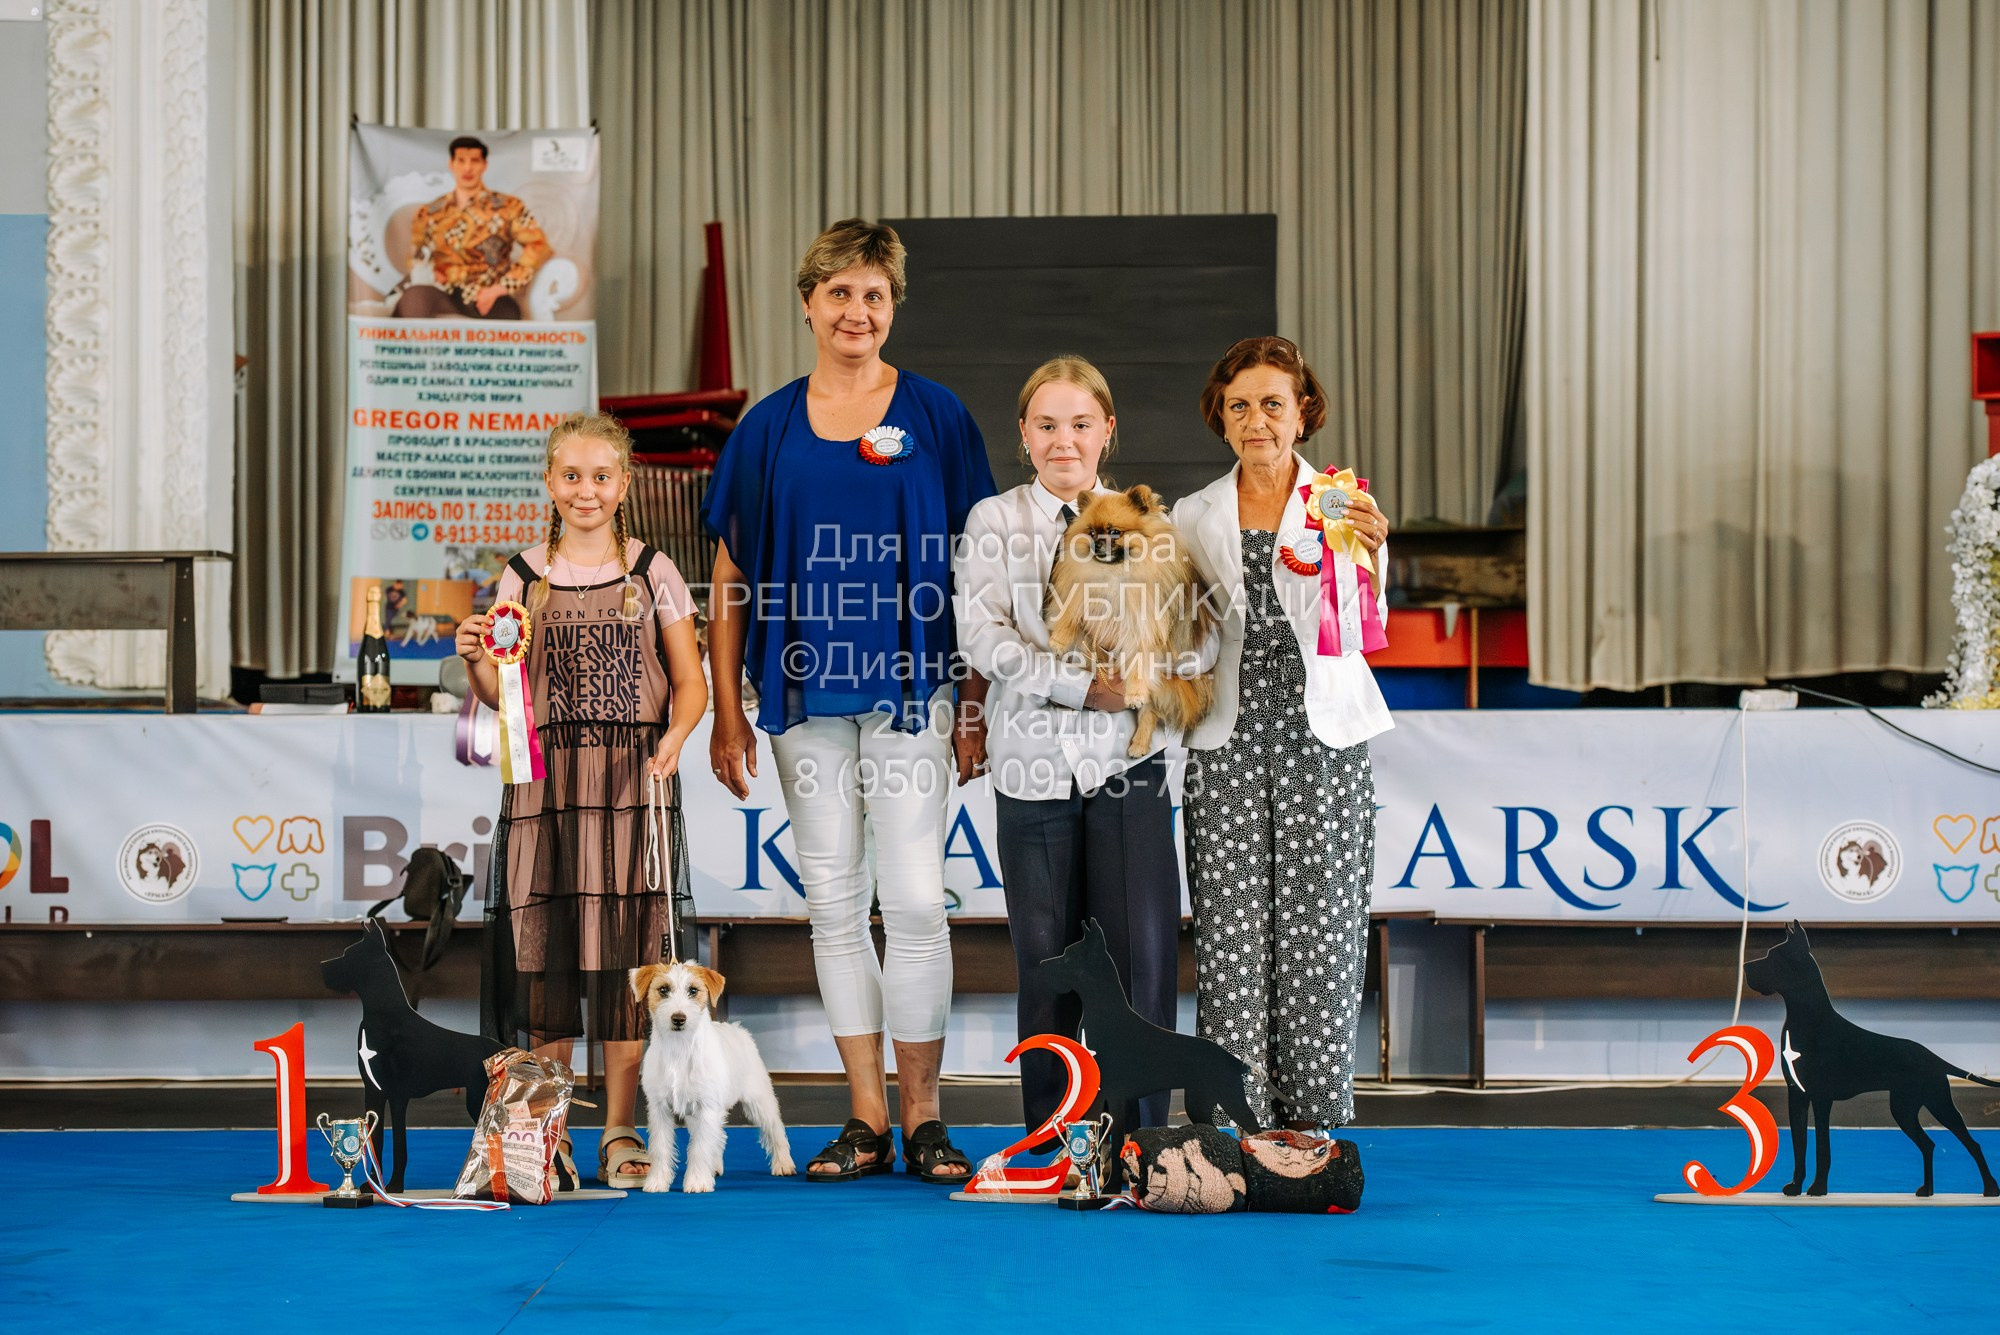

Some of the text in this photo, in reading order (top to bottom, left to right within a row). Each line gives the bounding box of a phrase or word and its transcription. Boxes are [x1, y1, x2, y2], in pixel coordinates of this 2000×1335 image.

[358, 327, 587, 344] УНИКАЛЬНАЯ ВОЗМОЖНОСТЬ
[353, 409, 459, 430] GREGOR
[373, 501, 437, 519] ЗАПИСЬ
[442, 502, 464, 520] ПО
[485, 504, 550, 522] 251-03-1
[434, 525, 548, 544] 8-913-534-03-1
[541, 610, 586, 621] BORN
[597, 607, 617, 618] TO
[543, 623, 643, 652] AWESOME
[254, 1022, 330, 1195] 1
[964, 1033, 1101, 1195] 2
[1682, 1025, 1780, 1197] 3
